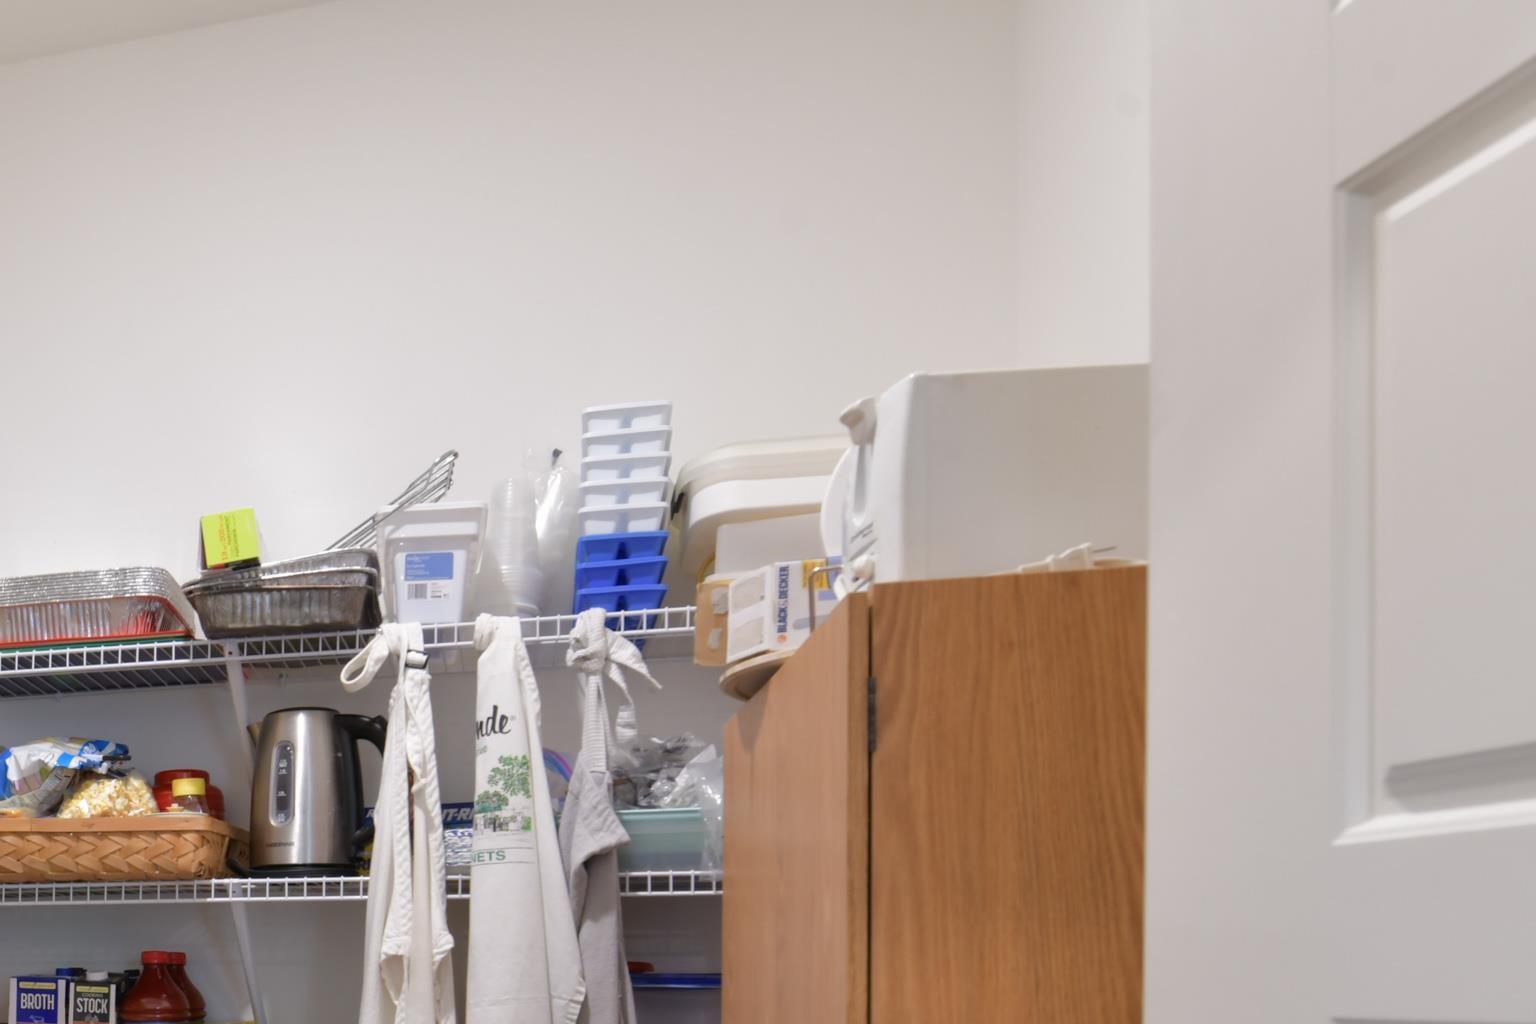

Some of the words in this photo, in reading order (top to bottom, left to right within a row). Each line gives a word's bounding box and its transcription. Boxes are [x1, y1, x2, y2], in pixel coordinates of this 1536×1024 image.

[778, 566, 790, 600] DECKER
[777, 606, 789, 634] BLACK
[20, 993, 55, 1010] BROTH
[76, 998, 109, 1014] STOCK
